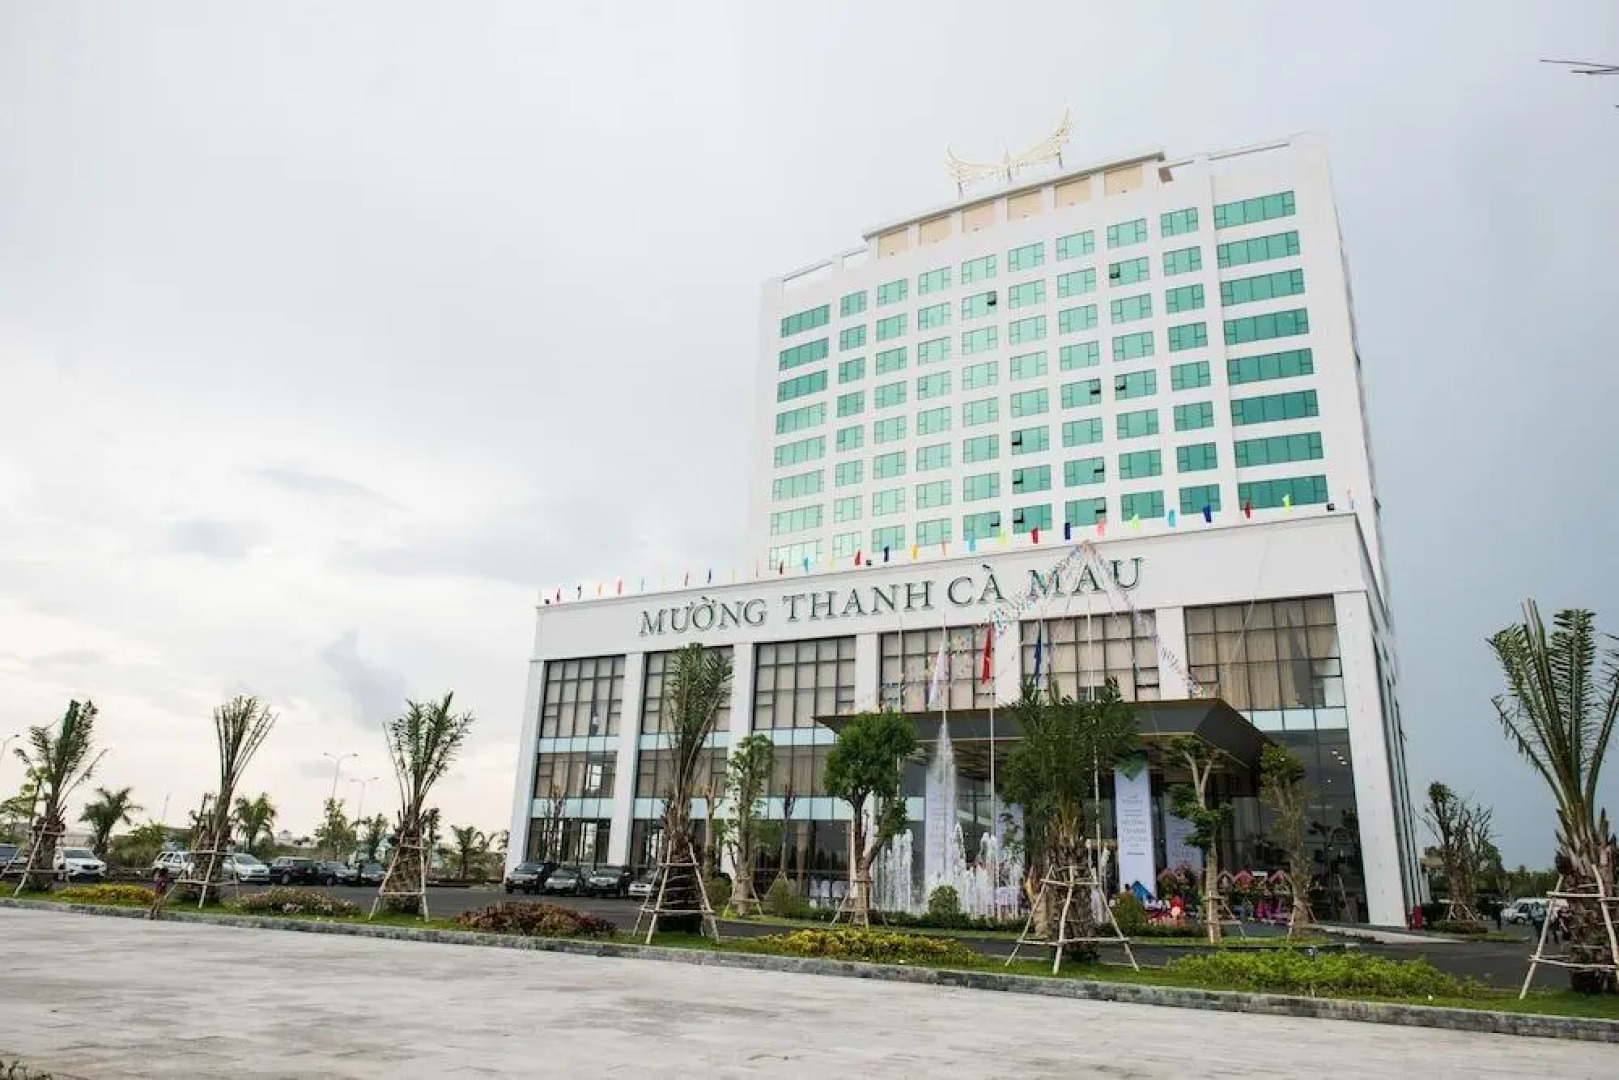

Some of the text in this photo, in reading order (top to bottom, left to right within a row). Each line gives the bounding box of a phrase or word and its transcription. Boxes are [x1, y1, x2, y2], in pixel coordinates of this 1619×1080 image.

[640, 556, 1144, 636] MƯỜNG THANH CÀ MAU
